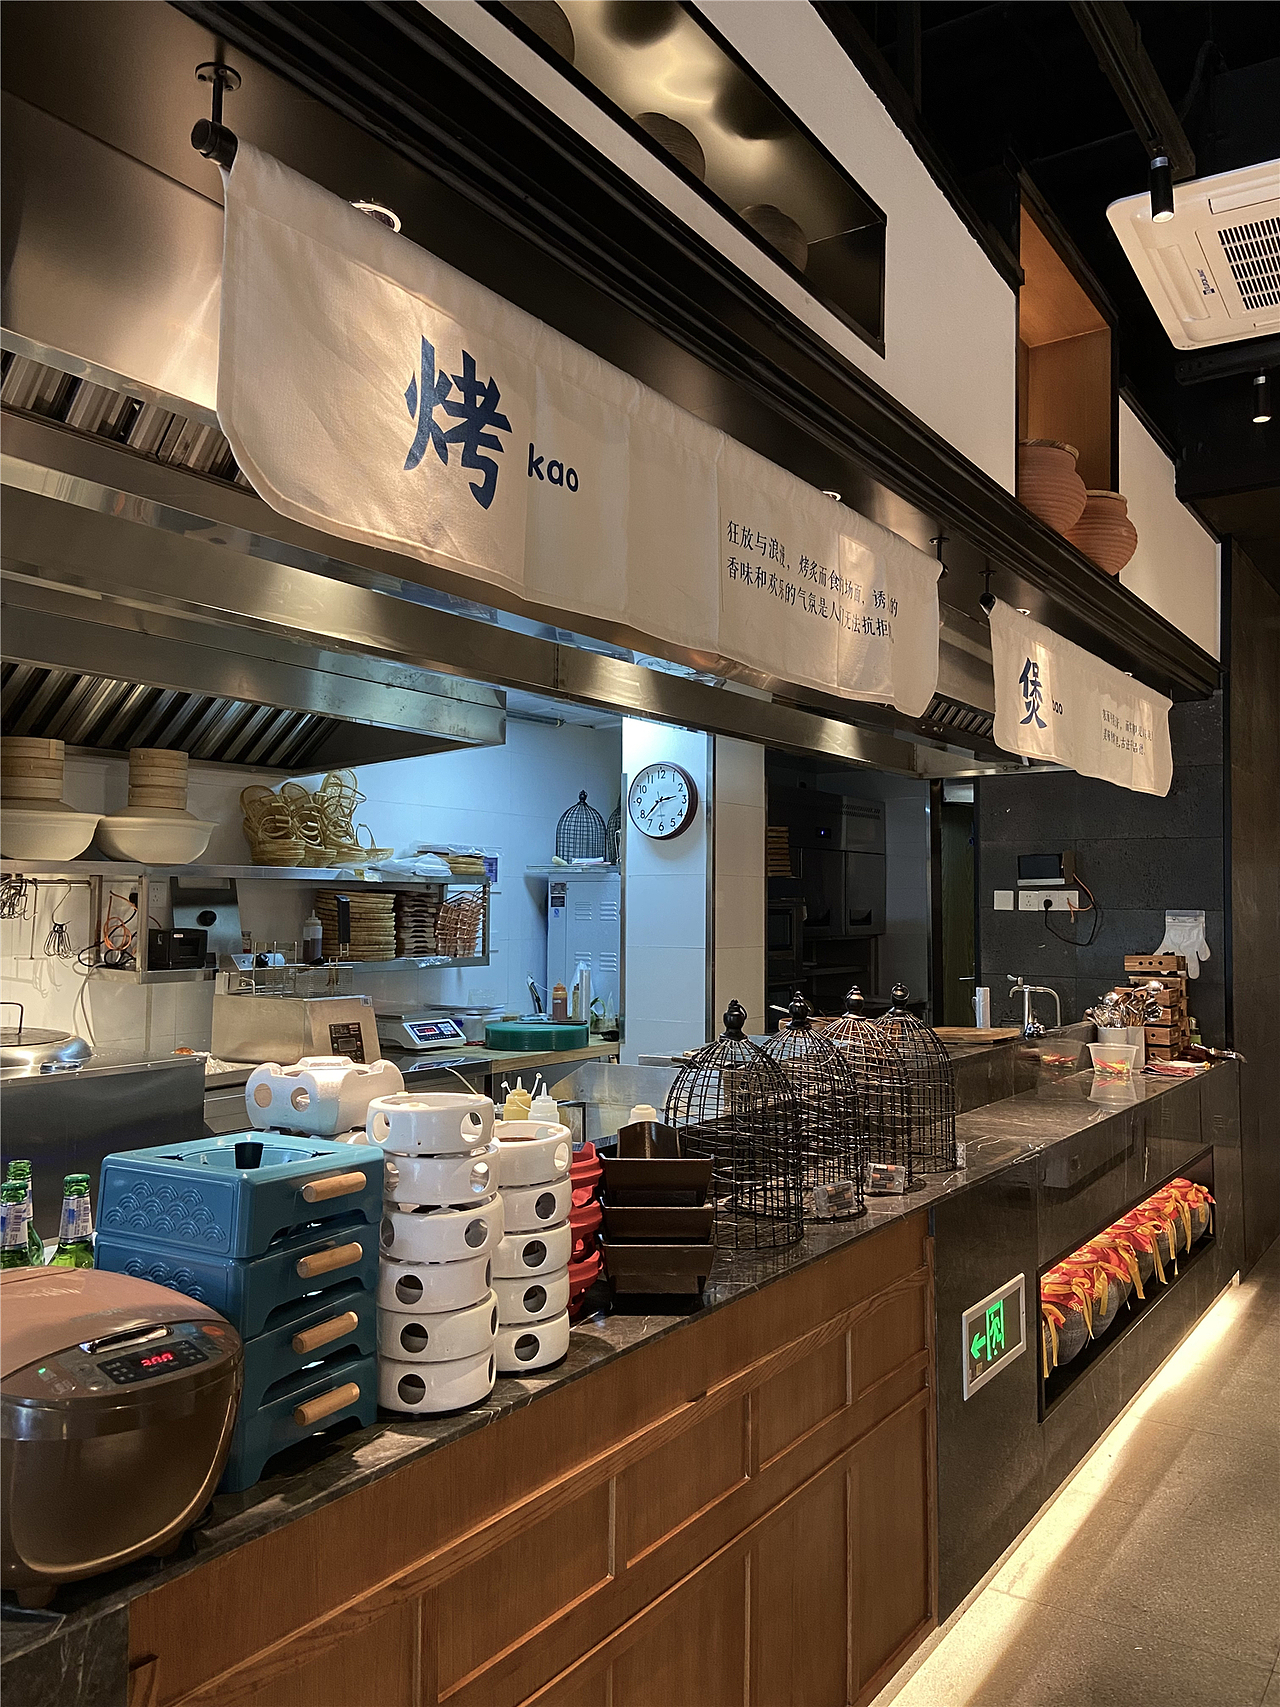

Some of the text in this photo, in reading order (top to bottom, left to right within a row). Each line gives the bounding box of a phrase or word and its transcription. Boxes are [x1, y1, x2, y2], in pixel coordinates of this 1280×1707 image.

[403, 334, 513, 510] 烤
[528, 442, 579, 492] kao
[1018, 657, 1048, 729] 煲
[647, 774, 654, 784] 11
[657, 769, 666, 780] 12
[639, 785, 647, 794] 10
[677, 783, 684, 792] 2
[636, 797, 642, 807] 9
[681, 795, 687, 804] 3
[640, 809, 646, 819] 8
[677, 808, 683, 818] 4
[647, 819, 653, 829] 7
[658, 821, 665, 831] 6
[670, 818, 676, 827] 5
